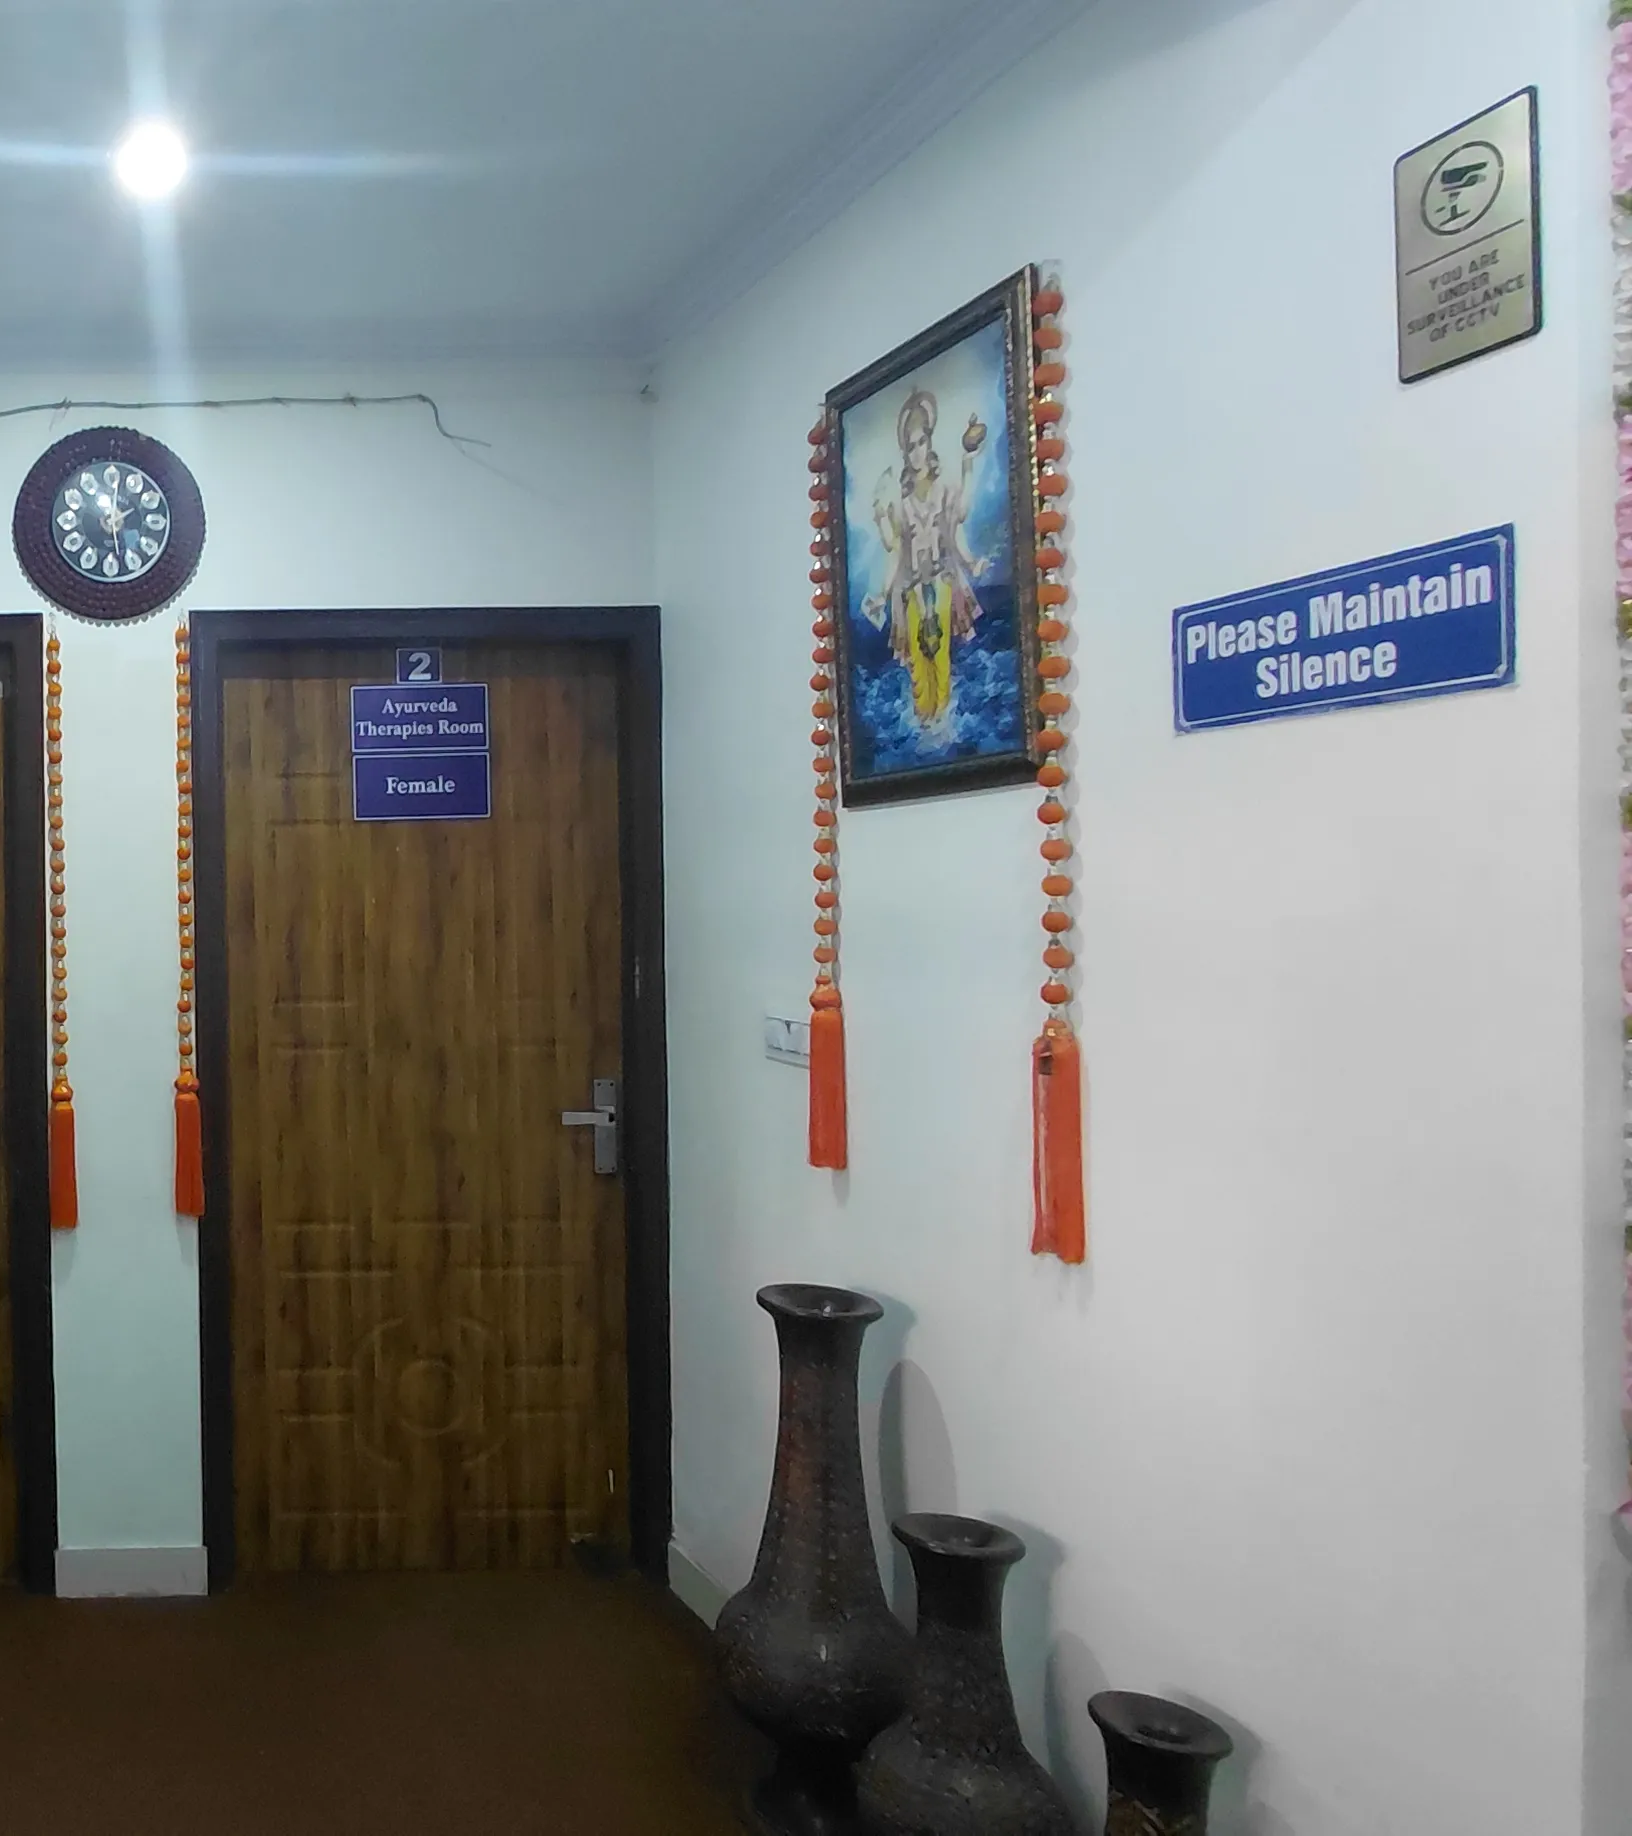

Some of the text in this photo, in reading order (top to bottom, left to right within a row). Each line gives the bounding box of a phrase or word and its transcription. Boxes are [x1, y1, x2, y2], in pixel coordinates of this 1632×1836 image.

[1429, 248, 1500, 291] YOU ARE
[1437, 271, 1490, 304] UNDER
[1407, 272, 1526, 335] SURVEILLANCE
[1429, 302, 1500, 342] OF CCTV
[1186, 562, 1493, 664] Please Maintain
[408, 652, 432, 681] 2
[1255, 641, 1397, 699] Silence
[381, 697, 458, 718] Ayurveda
[356, 720, 484, 740] Therapies Room
[386, 775, 456, 794] Female
